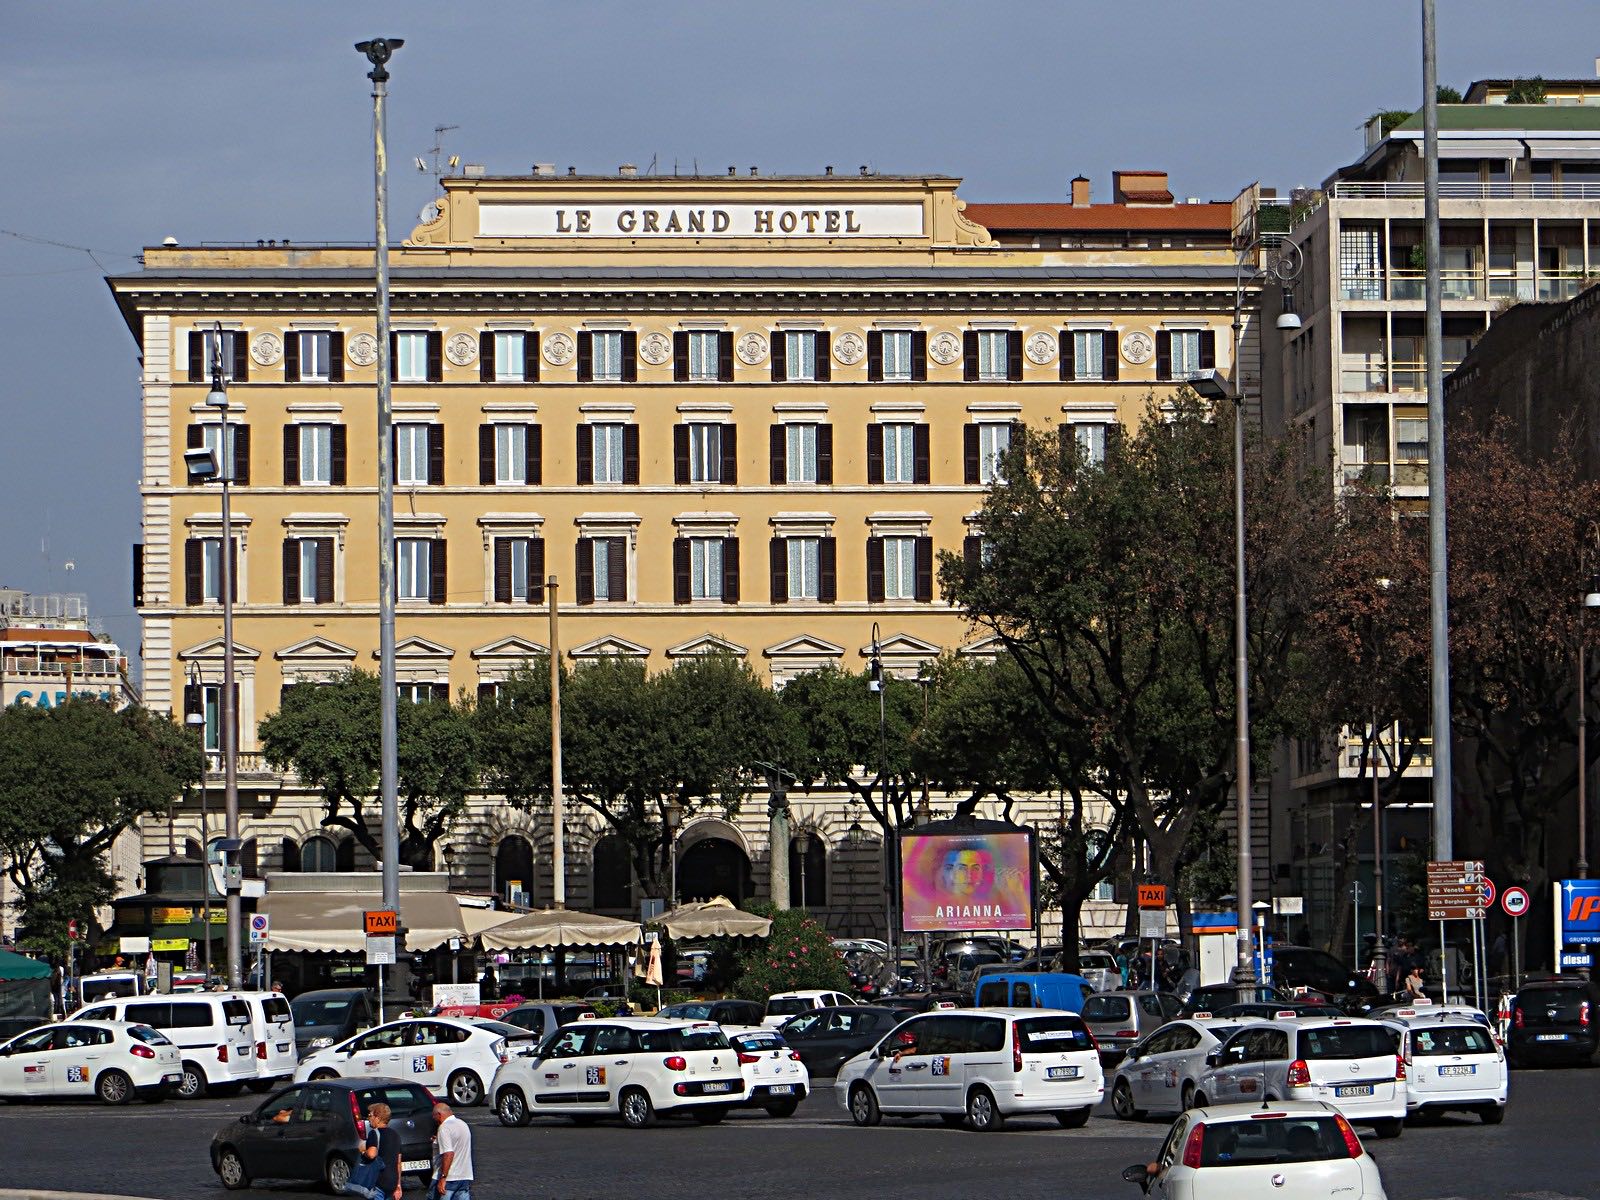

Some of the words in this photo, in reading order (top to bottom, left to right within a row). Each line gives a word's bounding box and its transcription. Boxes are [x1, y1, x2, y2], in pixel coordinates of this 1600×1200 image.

[556, 210, 591, 233] LE
[617, 210, 731, 233] GRAND
[754, 210, 861, 233] HOTEL
[1140, 890, 1164, 901] TAXI
[935, 905, 1002, 918] ARIANNA
[368, 916, 395, 927] TAXI
[1562, 954, 1590, 965] diesel
